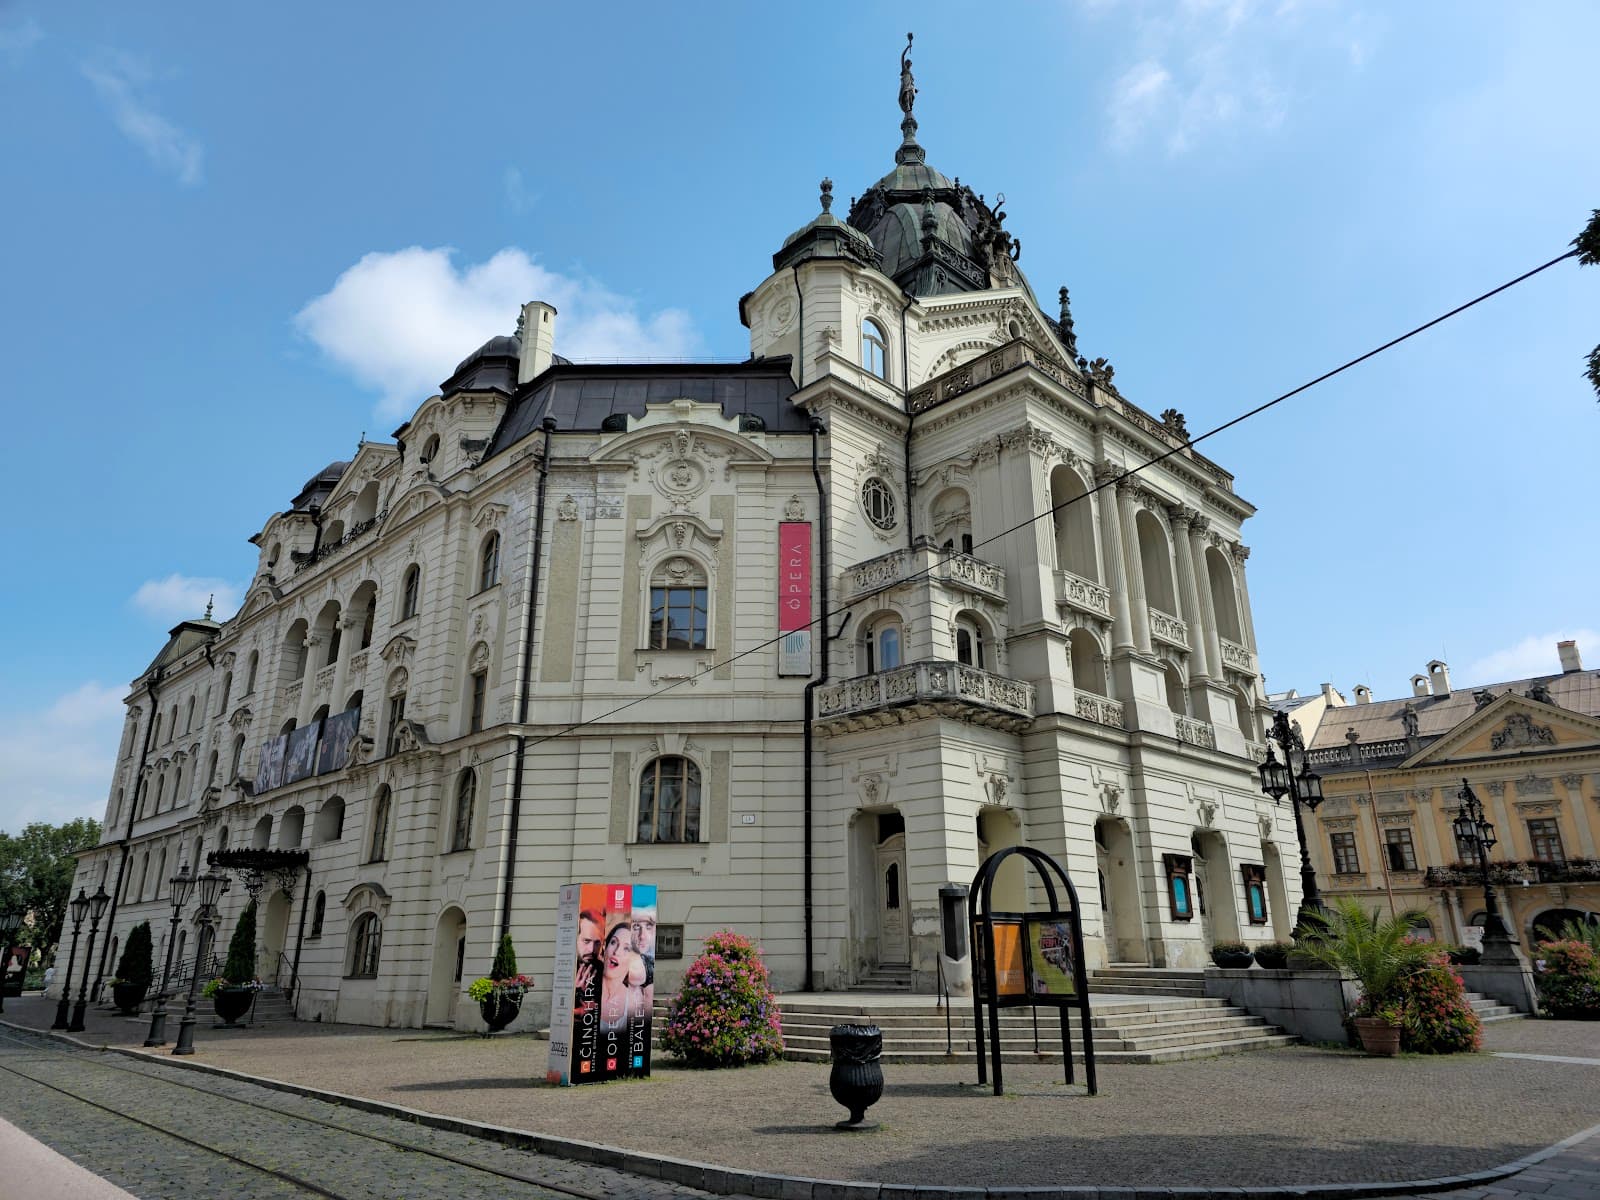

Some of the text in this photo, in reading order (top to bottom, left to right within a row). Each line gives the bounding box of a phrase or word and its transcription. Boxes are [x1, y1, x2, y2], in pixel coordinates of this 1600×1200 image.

[580, 974, 595, 1058] ČINOHRA
[607, 995, 618, 1055] OPERA
[634, 998, 645, 1052] BALET
